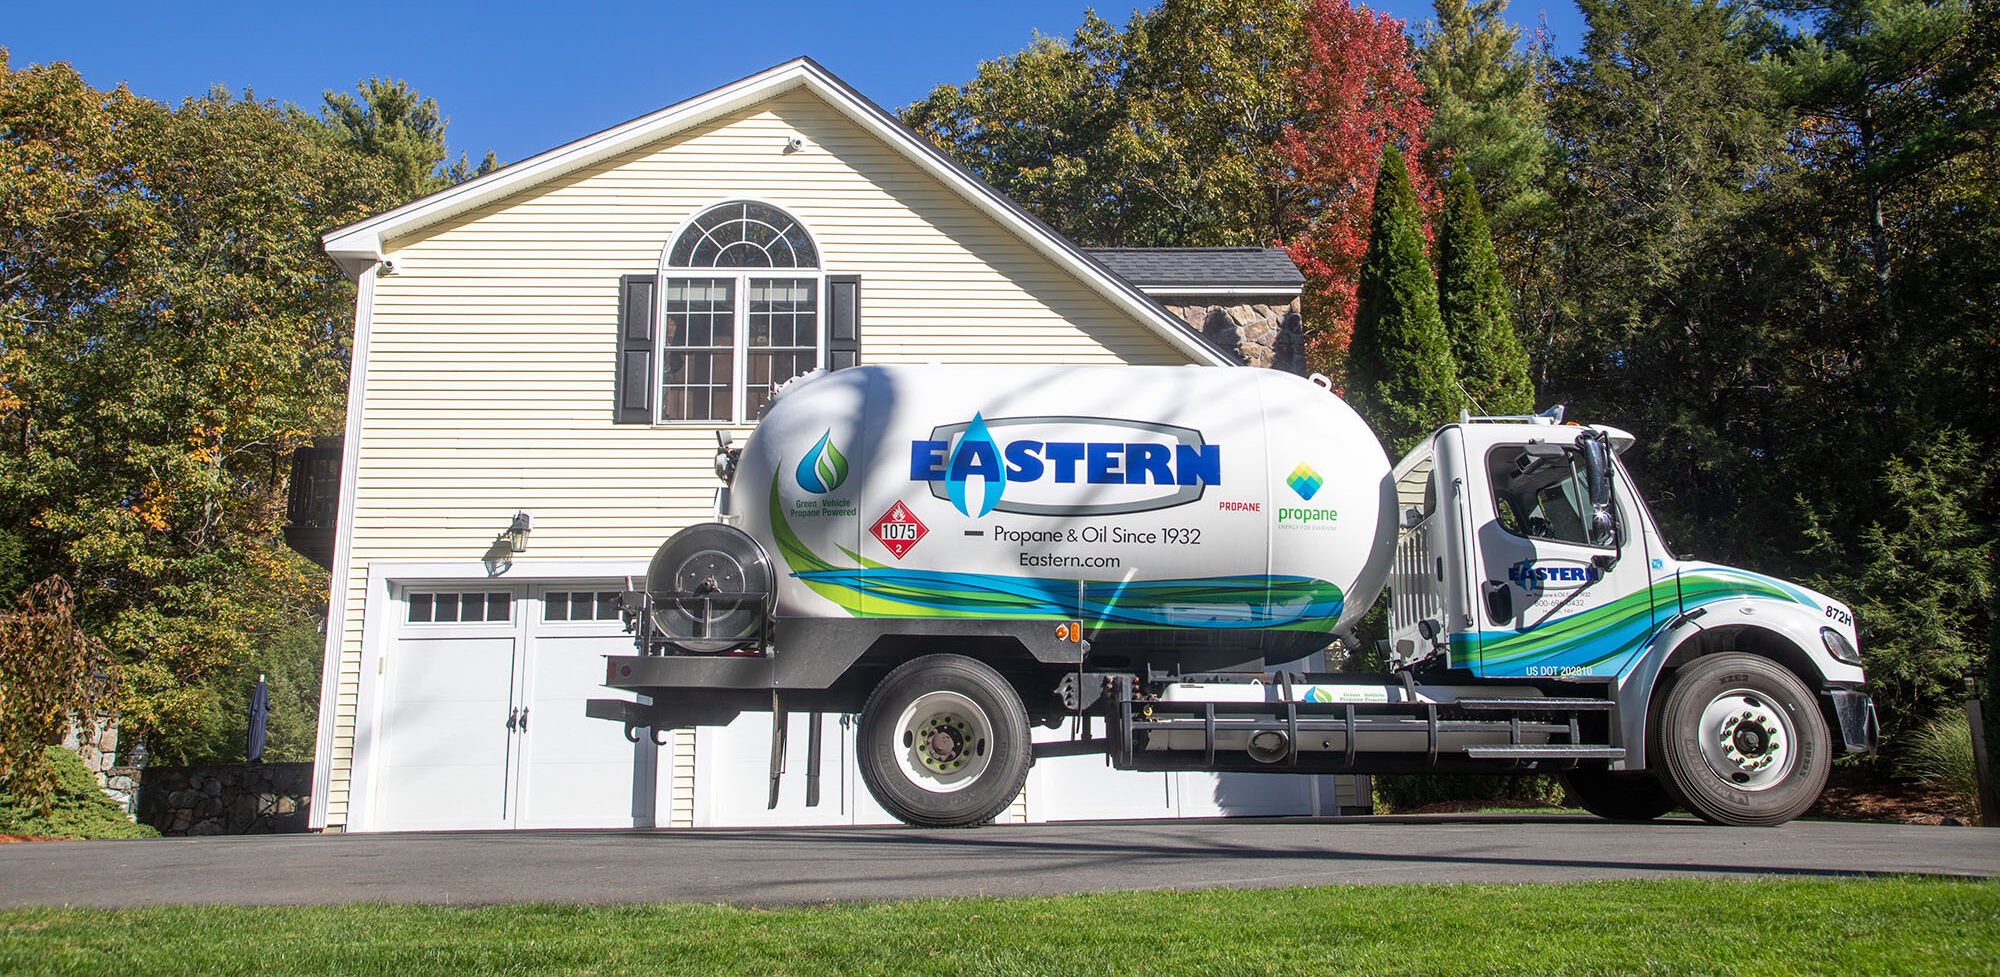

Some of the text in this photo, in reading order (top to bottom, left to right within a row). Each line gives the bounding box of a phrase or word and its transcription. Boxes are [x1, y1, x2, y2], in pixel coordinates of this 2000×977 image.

[910, 440, 1221, 486] EASTERN
[796, 498, 850, 508] Green Vehicle
[1219, 501, 1261, 512] PROPANE
[790, 508, 857, 517] Propane Powered
[1278, 507, 1338, 523] propane
[882, 524, 916, 540] 1075
[994, 526, 1201, 546] Propane & Oil Since 1932
[895, 544, 902, 553] 2
[1020, 553, 1121, 568] Eastern.com
[1508, 567, 1598, 581] EASTERN
[1825, 605, 1852, 627] 872H
[1526, 666, 1593, 676] US DOT 202810
